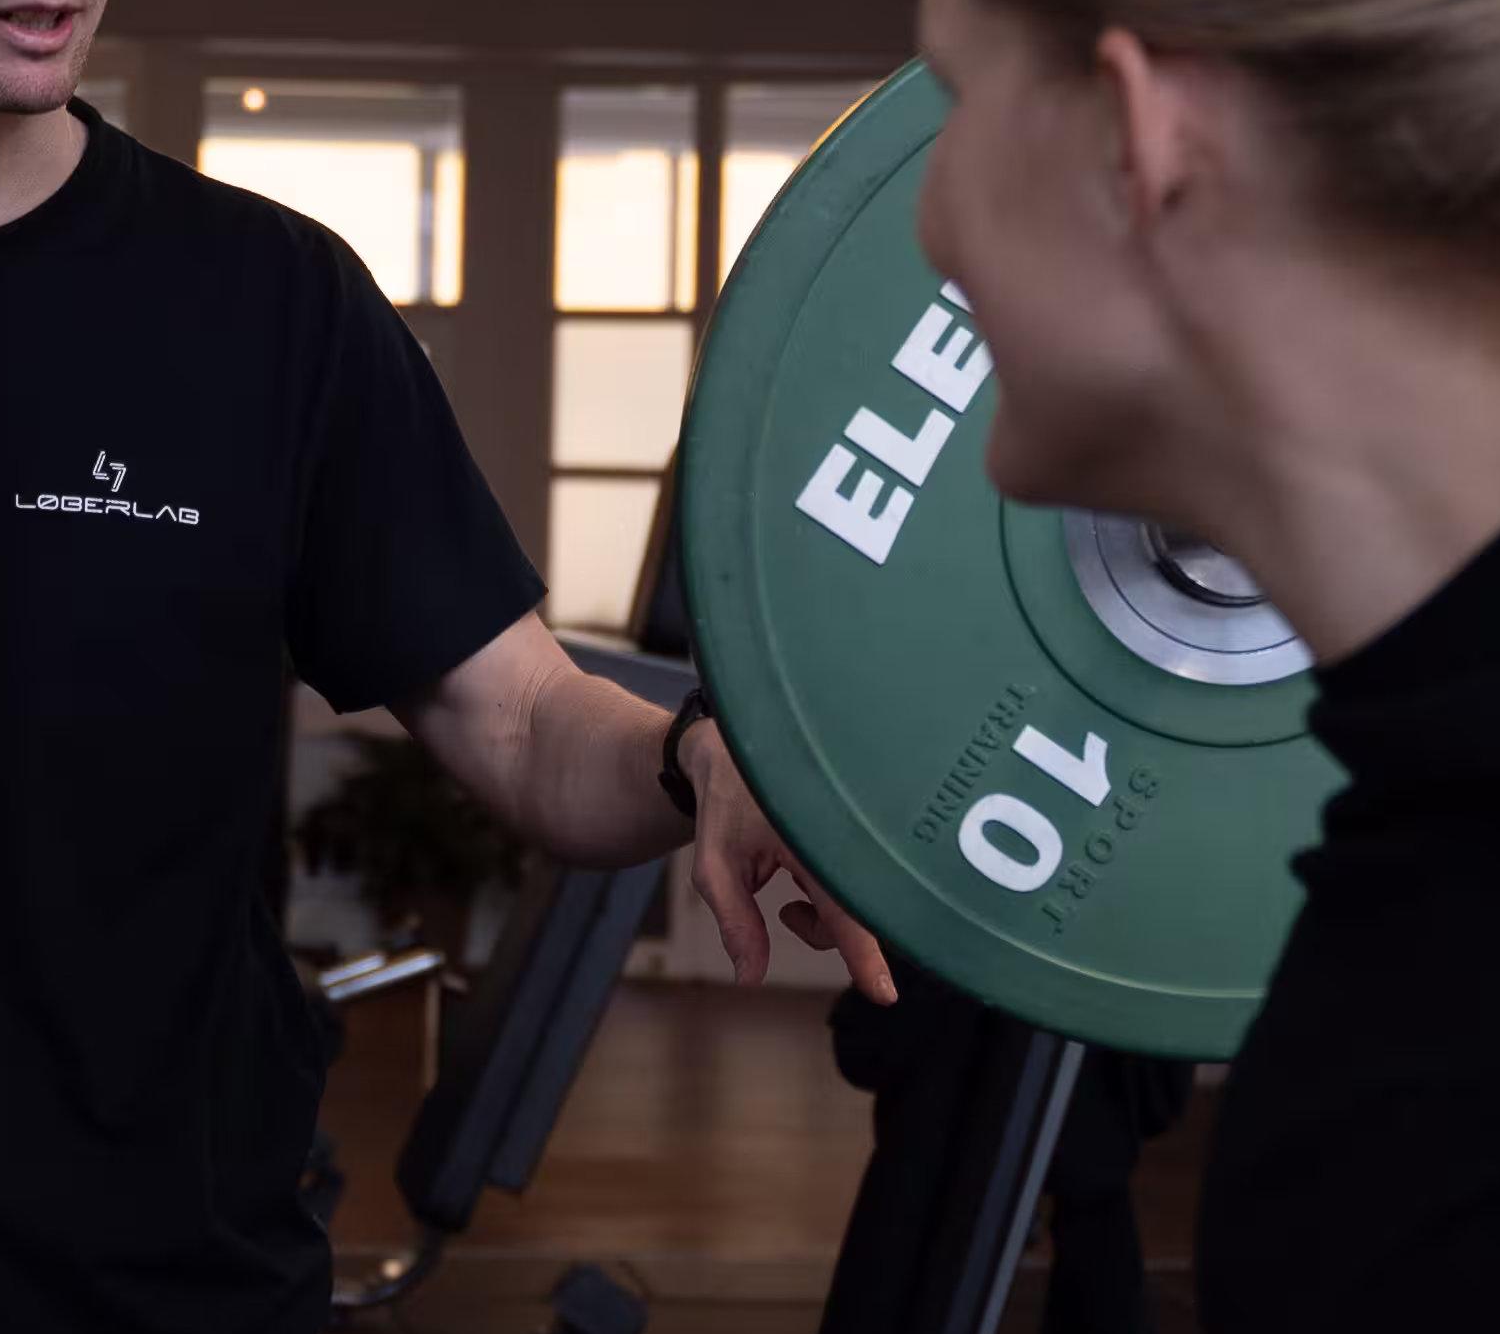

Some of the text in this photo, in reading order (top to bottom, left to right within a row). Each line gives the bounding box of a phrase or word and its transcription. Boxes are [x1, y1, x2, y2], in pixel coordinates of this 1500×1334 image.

[795, 277, 994, 567] ELE
[911, 681, 1038, 845] TRAINING
[957, 723, 1112, 894] 10
[1041, 763, 1160, 937] SPORT
